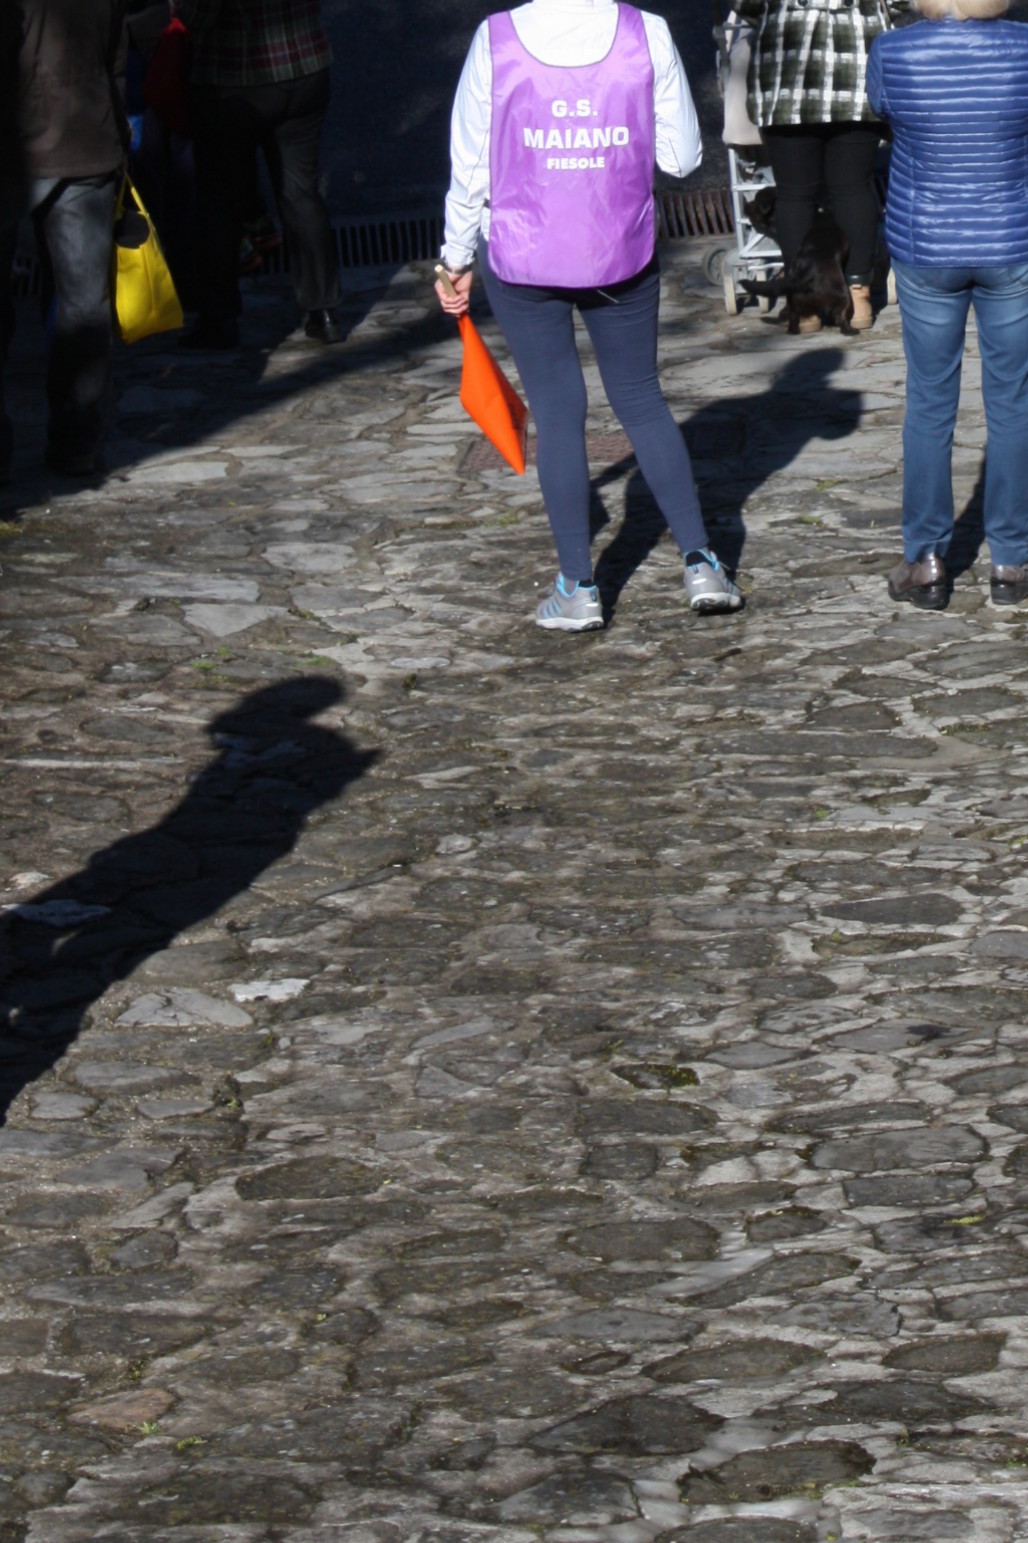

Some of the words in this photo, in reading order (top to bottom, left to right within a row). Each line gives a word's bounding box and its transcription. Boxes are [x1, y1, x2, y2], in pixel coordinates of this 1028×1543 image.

[551, 99, 598, 118] G.S.
[523, 126, 629, 149] MAIANO
[546, 156, 605, 170] FIESOLE
